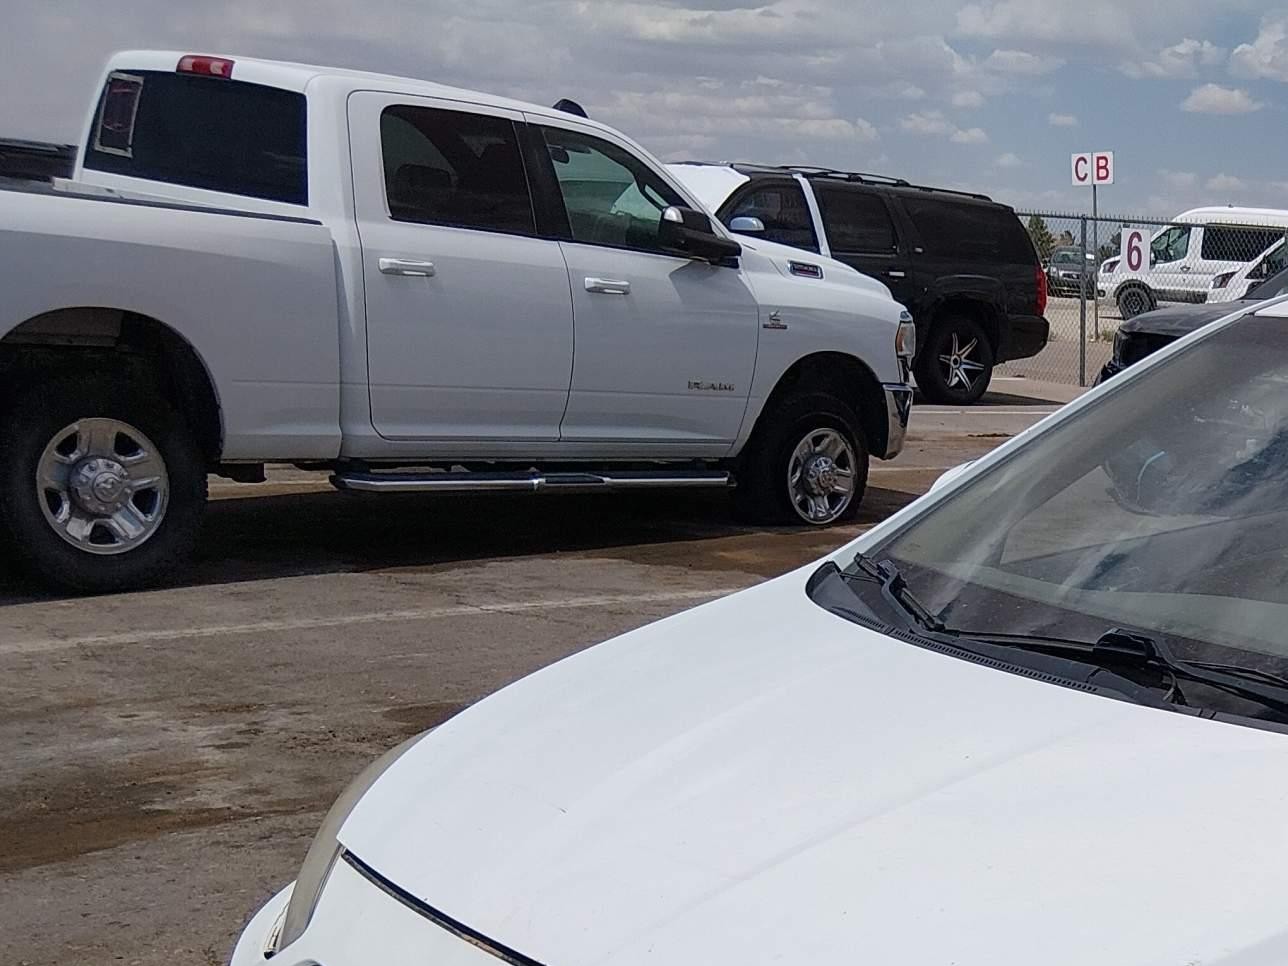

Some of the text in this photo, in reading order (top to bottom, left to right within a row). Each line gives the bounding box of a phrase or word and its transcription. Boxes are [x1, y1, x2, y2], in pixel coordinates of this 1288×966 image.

[1075, 156, 1110, 182] C B
[1127, 231, 1143, 272] 6
